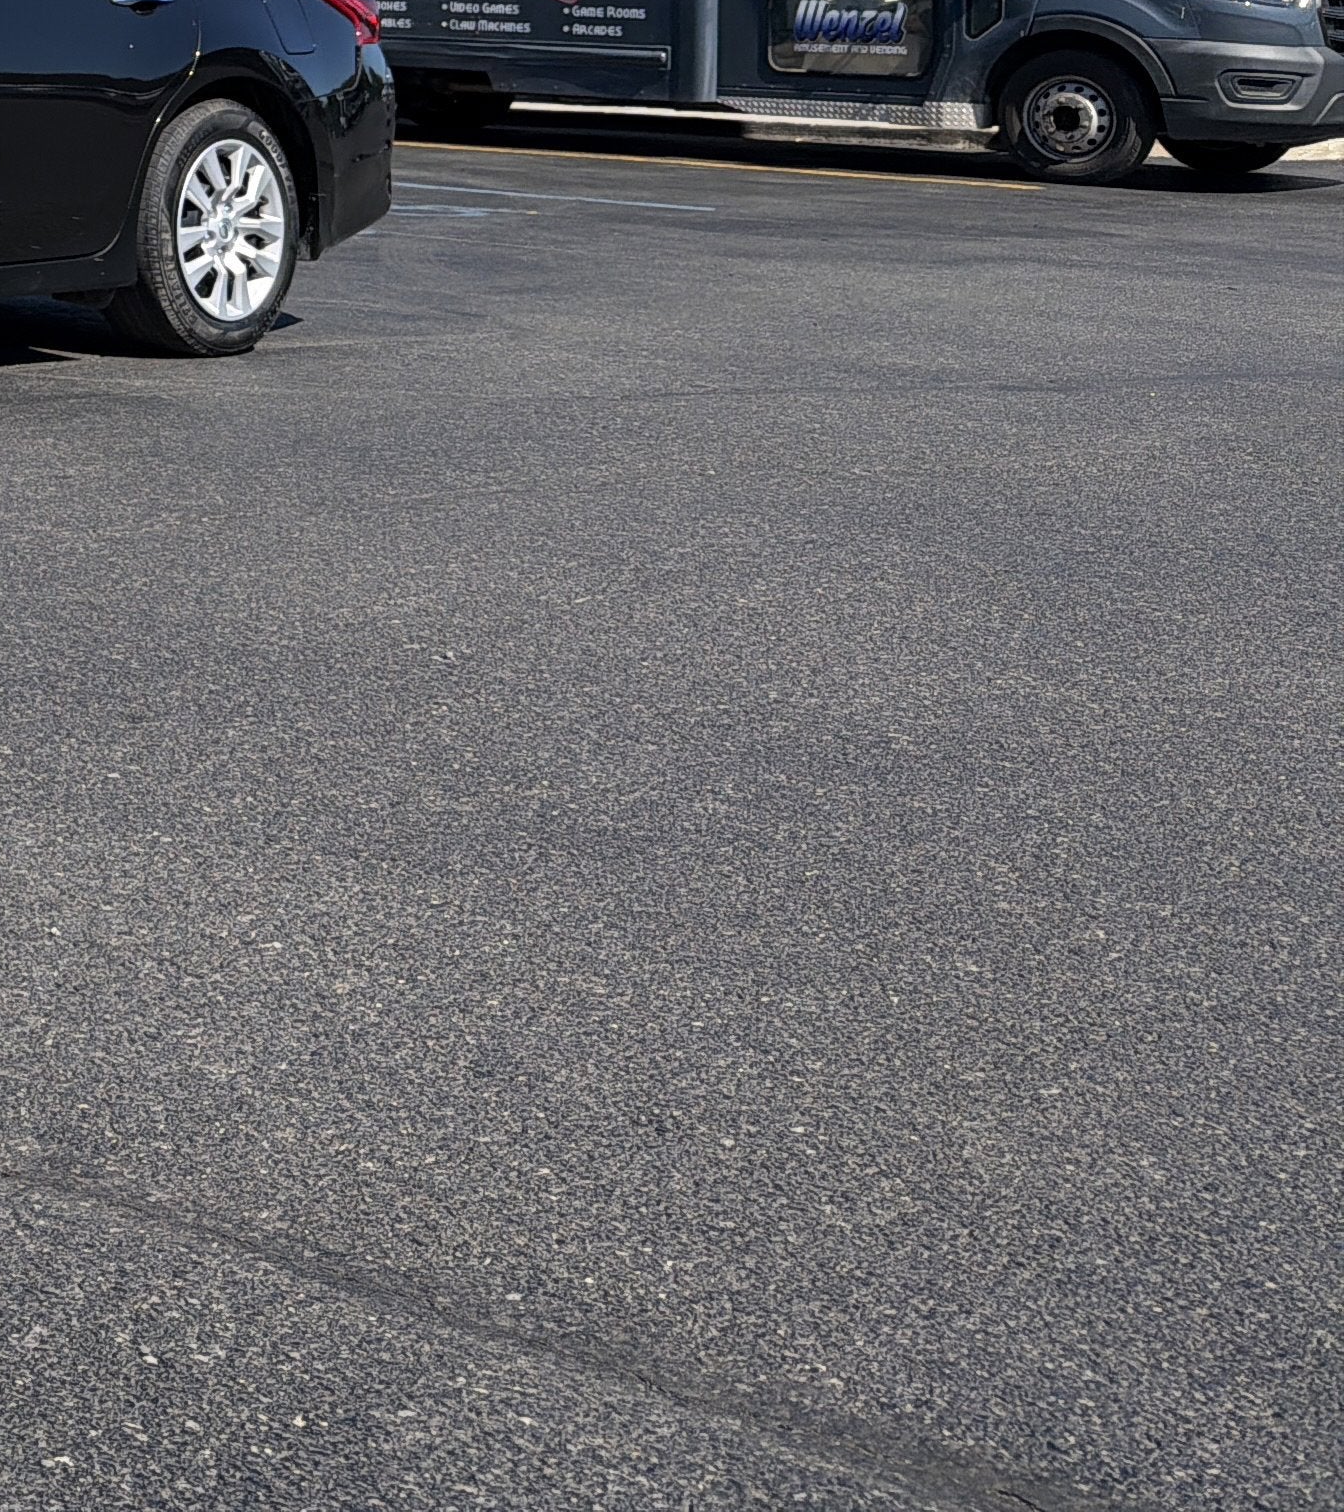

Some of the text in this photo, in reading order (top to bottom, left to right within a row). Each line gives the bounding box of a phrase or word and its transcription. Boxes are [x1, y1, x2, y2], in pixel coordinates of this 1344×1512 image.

[449, 1, 520, 15] VIDEO GAMES
[572, 5, 646, 19] GAME ROOMS
[449, 19, 531, 33] CLAW MACHINES
[794, 0, 908, 44] Wenzel
